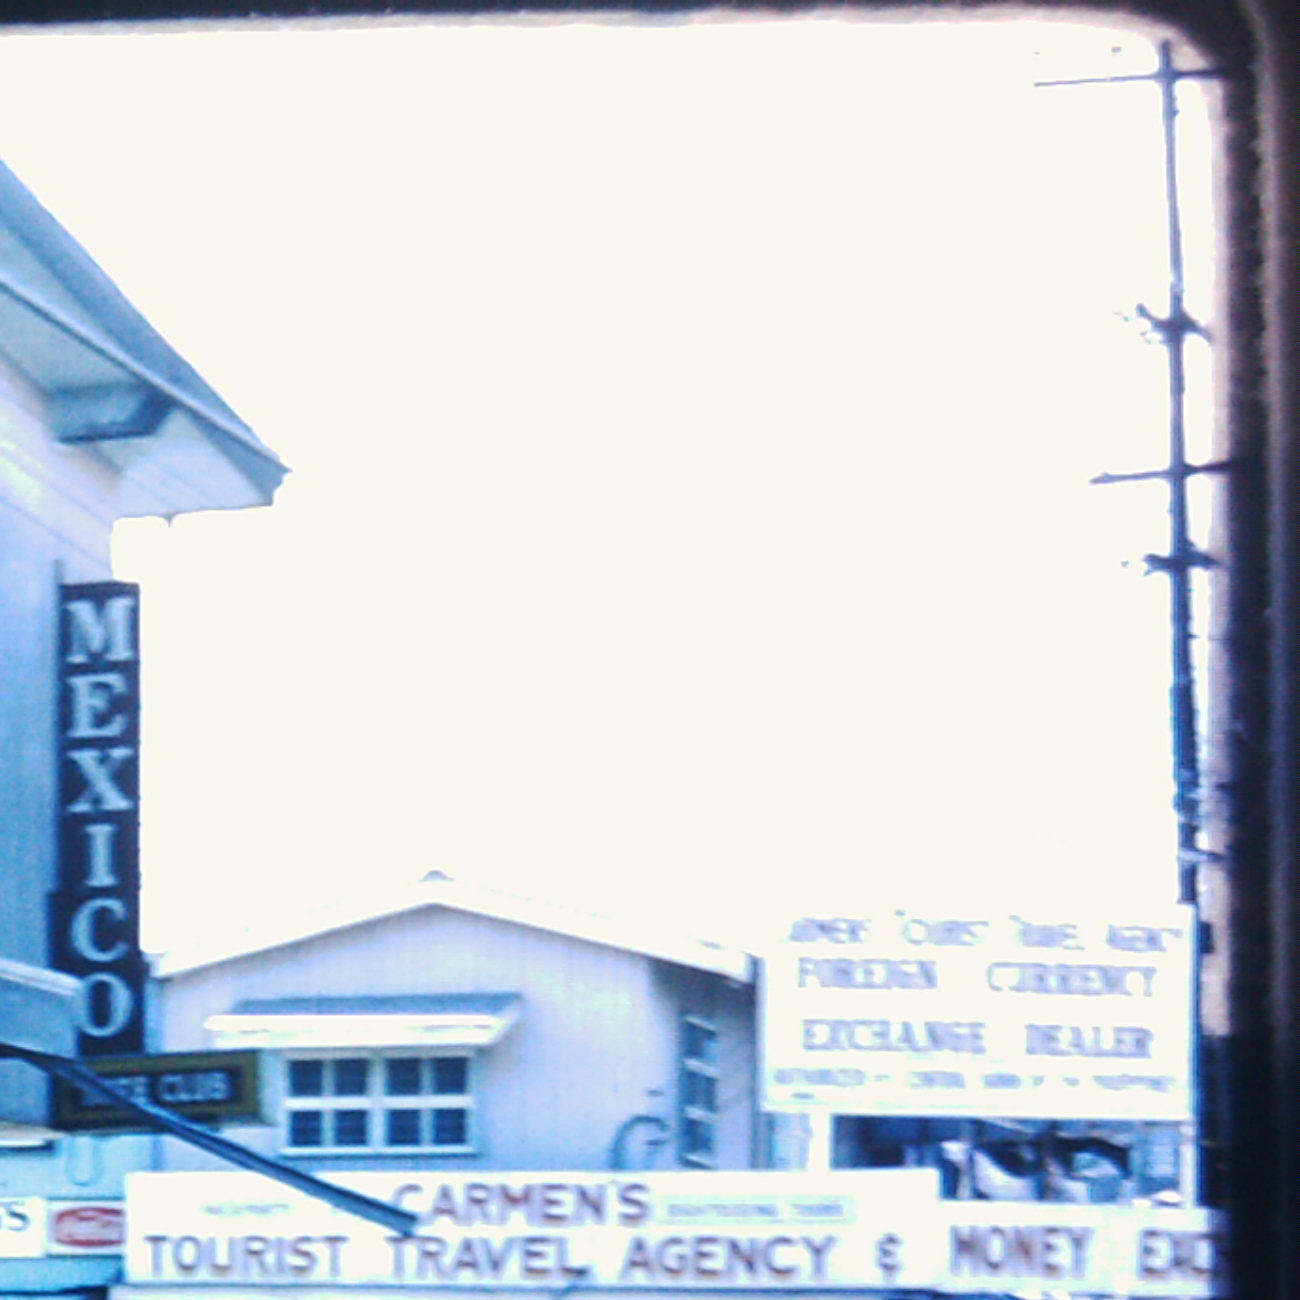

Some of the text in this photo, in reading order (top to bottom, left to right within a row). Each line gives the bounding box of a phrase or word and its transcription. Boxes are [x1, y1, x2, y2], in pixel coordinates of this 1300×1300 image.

[64, 594, 134, 1039] MEXICO
[895, 909, 989, 947] OURS
[797, 957, 1157, 997] FOREIGN CURRENCY
[802, 1018, 1154, 1058] EXCHANGE DEALER
[157, 1070, 231, 1104] CLUB
[389, 1181, 650, 1228] CARMEN'S
[143, 1234, 350, 1279] TOURIST
[384, 1234, 590, 1281] TRAVEL
[617, 1235, 837, 1281] AGENCY
[950, 1225, 1095, 1278] MONEY
